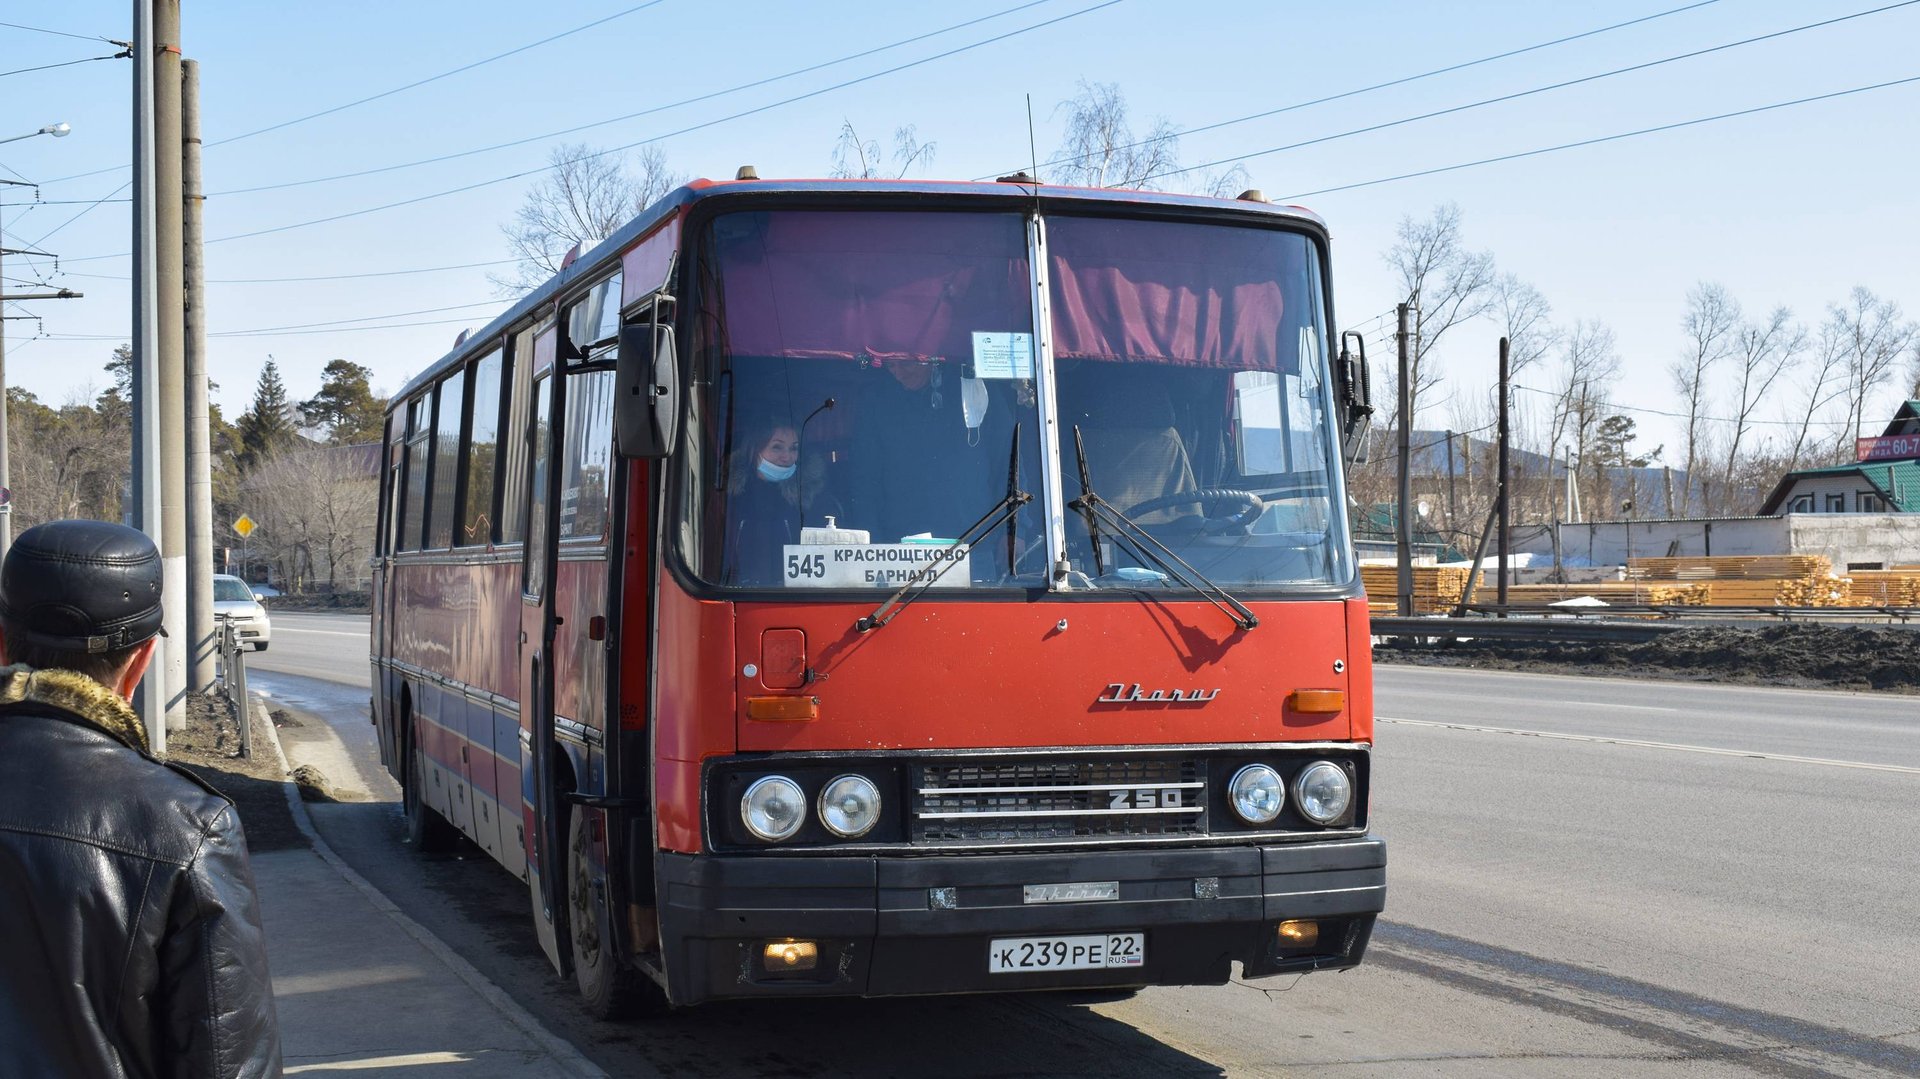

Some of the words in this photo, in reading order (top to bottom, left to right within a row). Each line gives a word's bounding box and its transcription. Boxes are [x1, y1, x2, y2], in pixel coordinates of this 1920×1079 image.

[834, 549, 966, 563] КРАСНОЩЕКОВО
[787, 554, 826, 579] 545
[864, 569, 938, 583] БАРНАУЛ
[1098, 683, 1221, 702] Ikarus
[1110, 937, 1135, 956] 22
[1108, 956, 1127, 964] RUS
